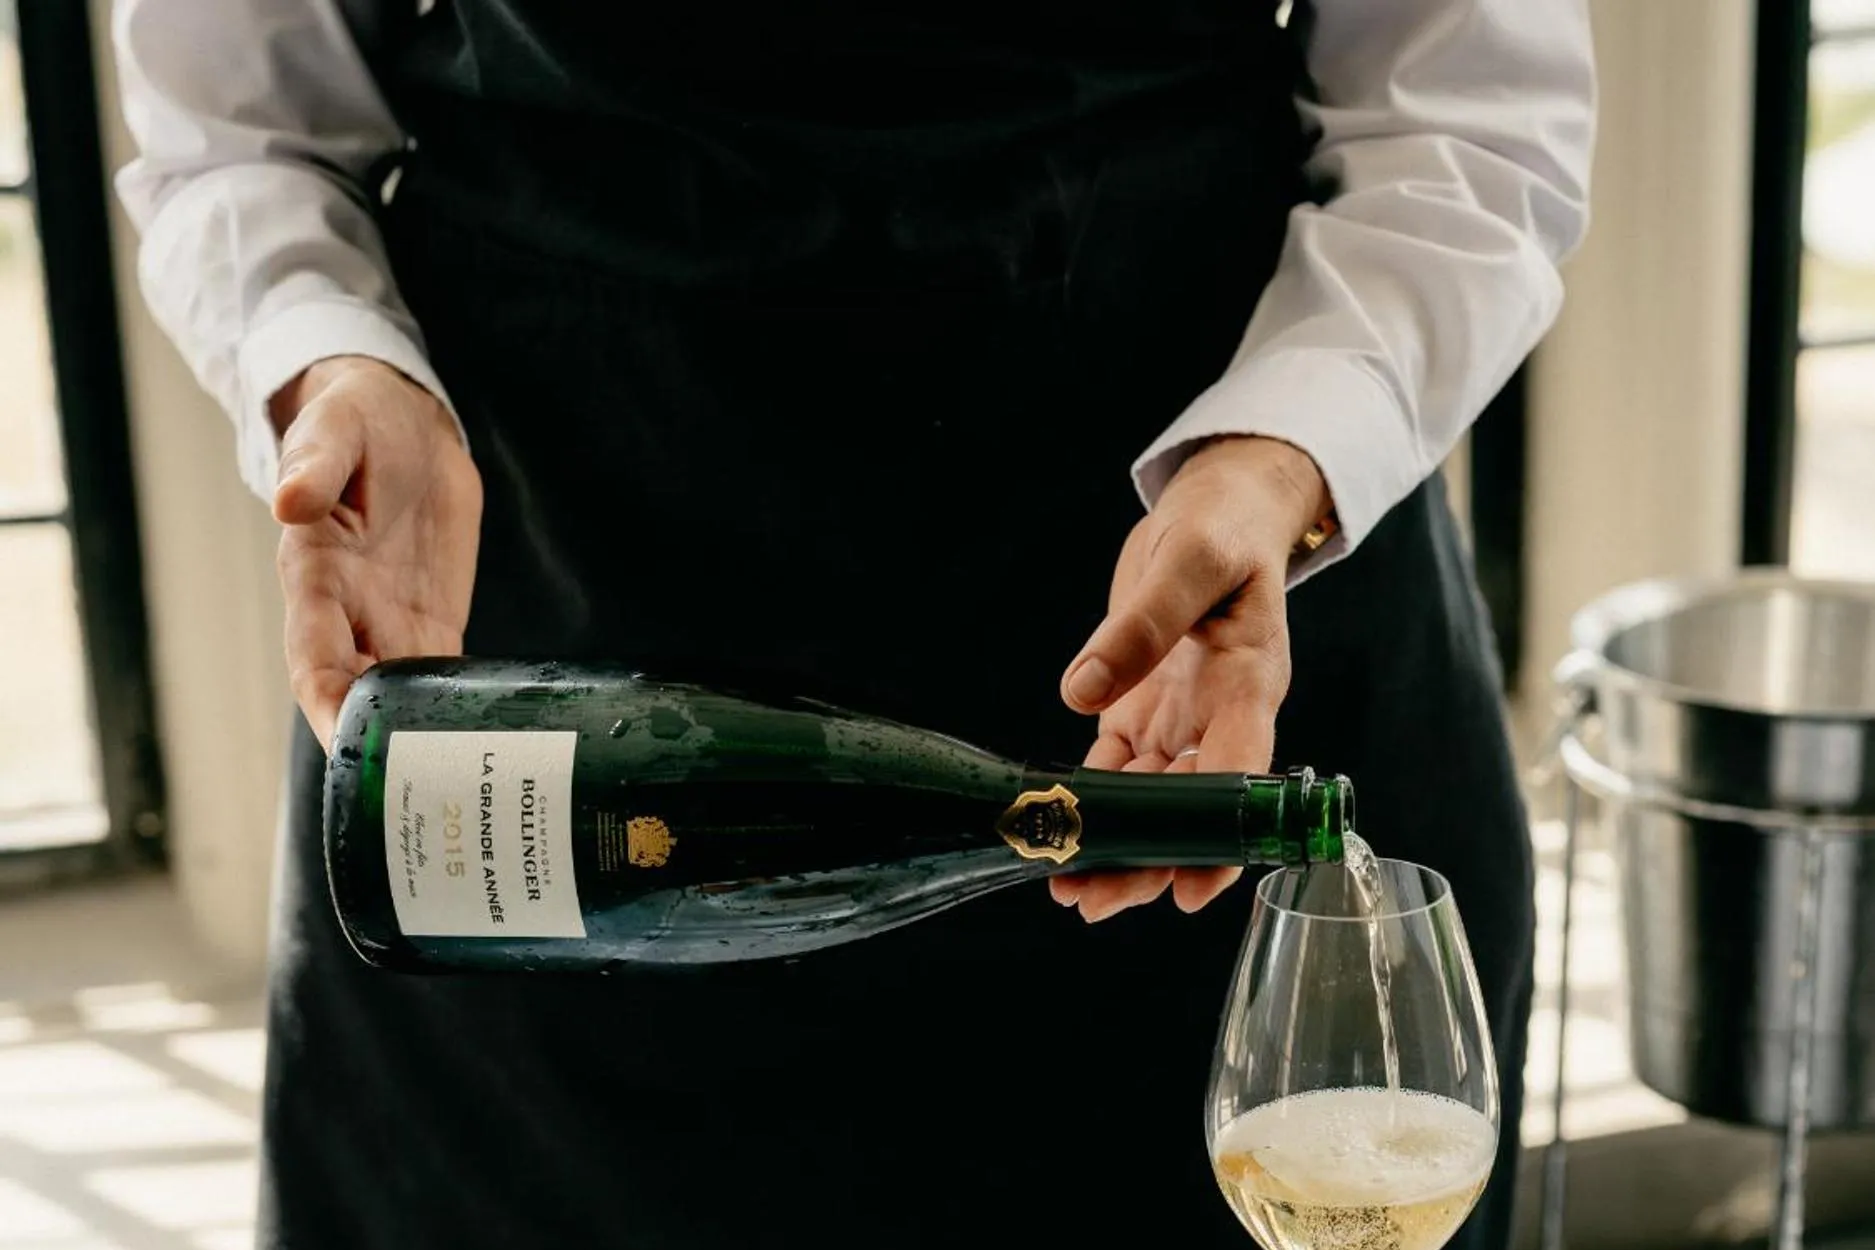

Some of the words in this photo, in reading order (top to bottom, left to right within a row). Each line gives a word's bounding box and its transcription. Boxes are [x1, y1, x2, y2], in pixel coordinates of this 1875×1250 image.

[483, 752, 495, 776] LA
[443, 800, 465, 878] 2015
[480, 782, 494, 861] GRANDE
[521, 778, 541, 901] BOLLINGER
[539, 796, 551, 885] CHAMPAGNE
[483, 867, 505, 924] ANNÉE
